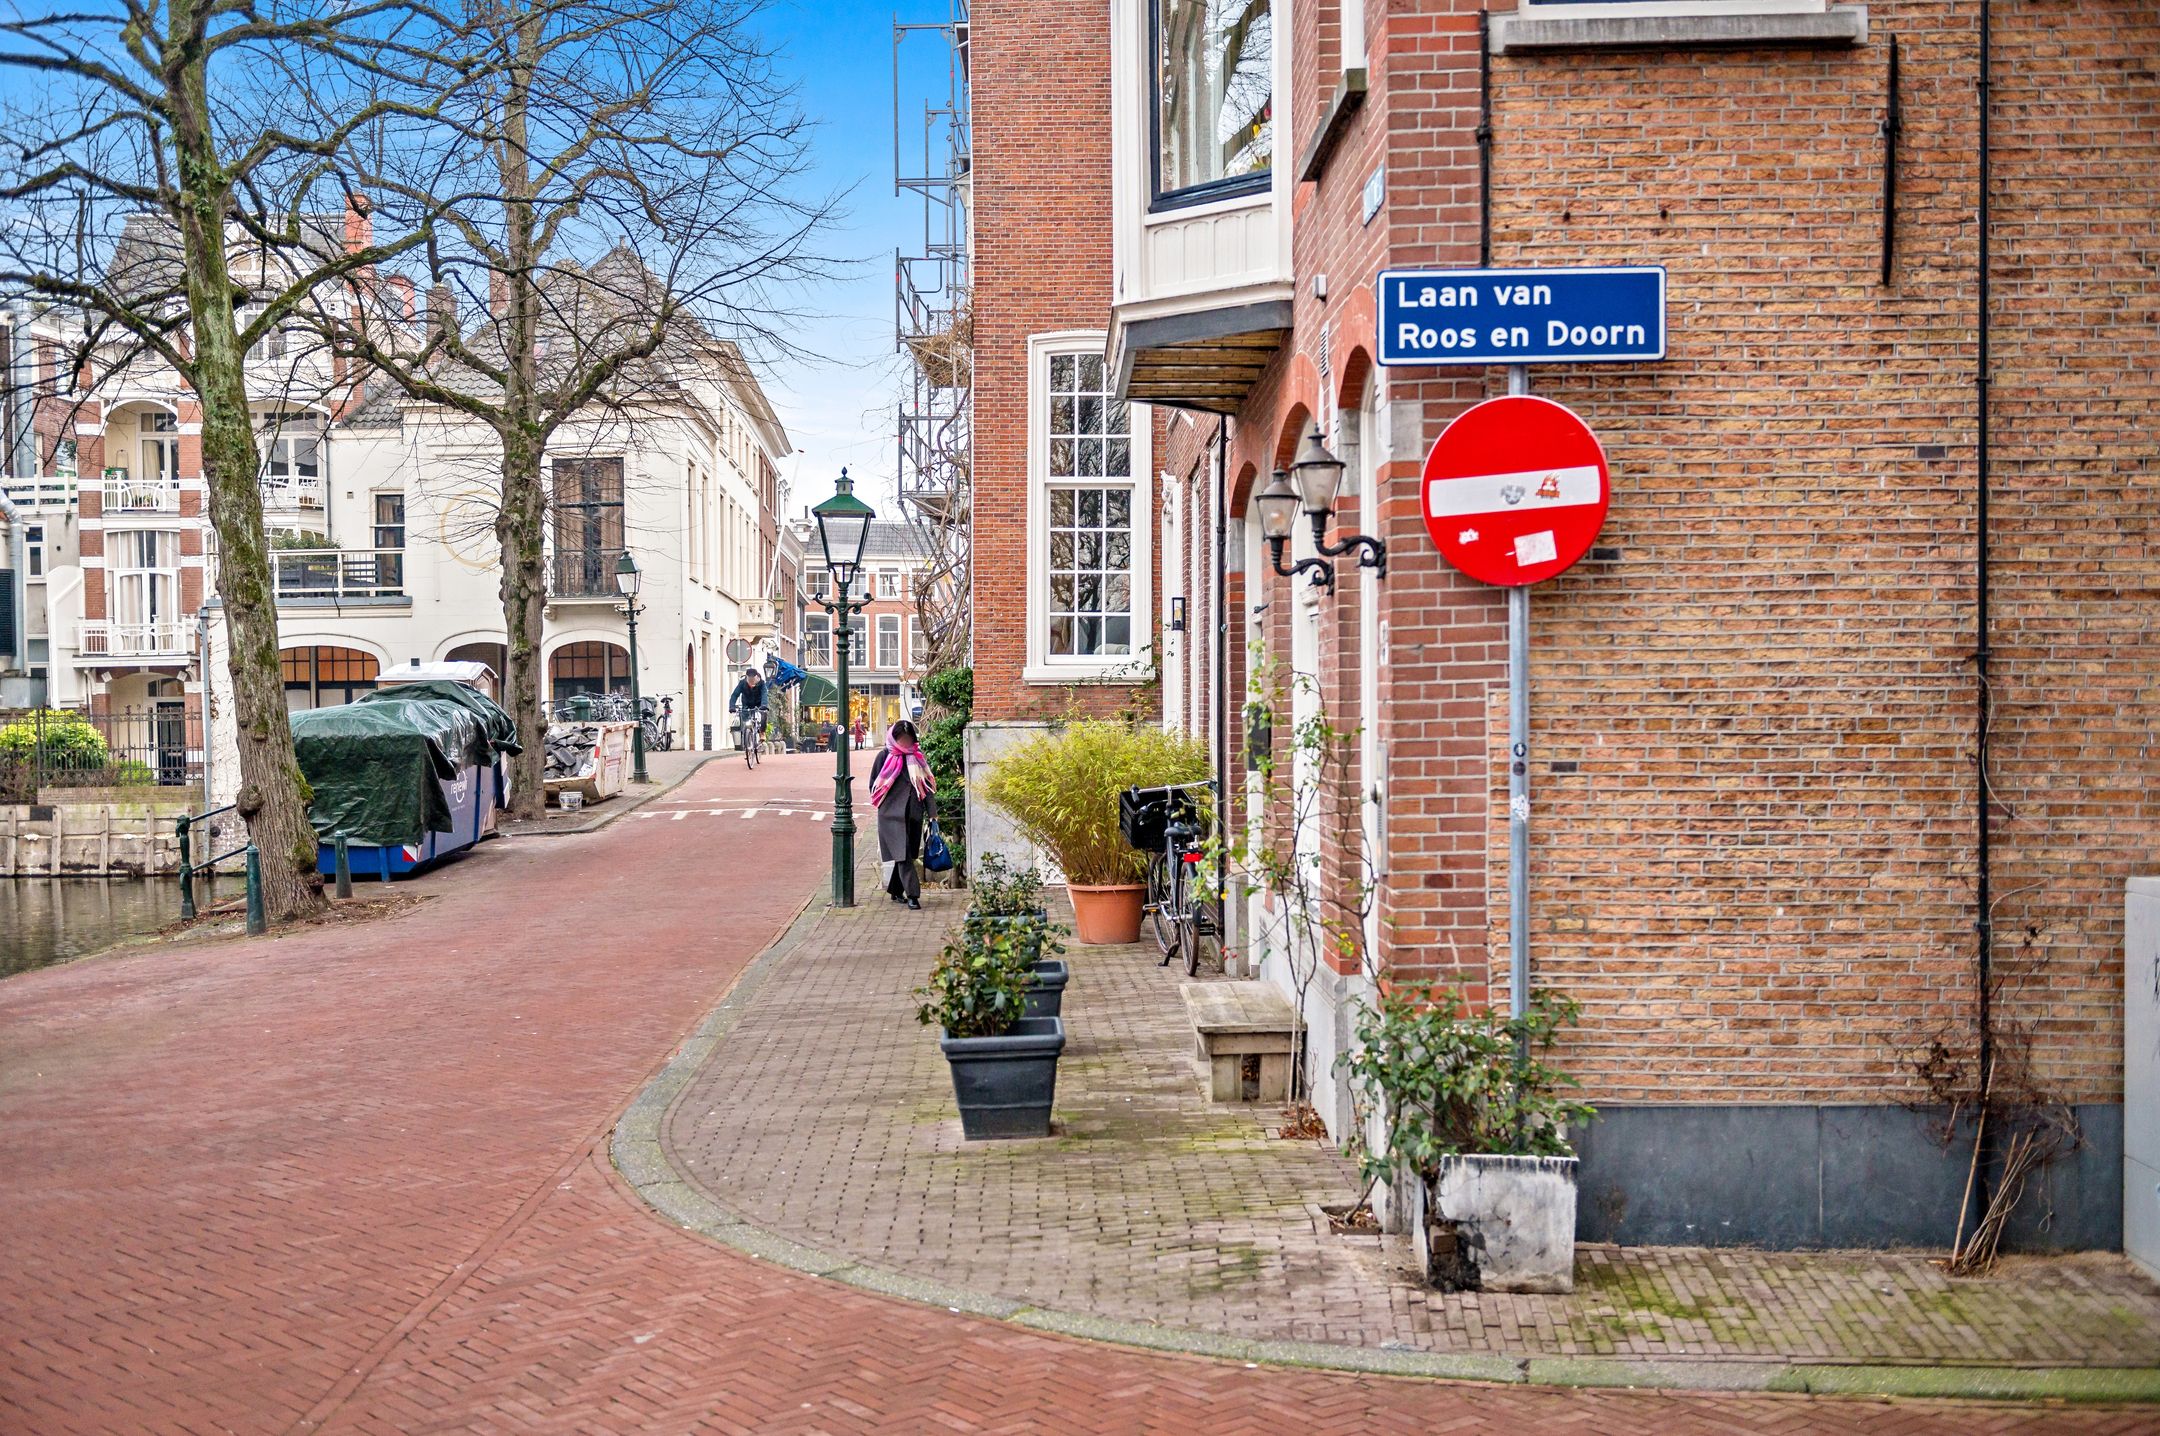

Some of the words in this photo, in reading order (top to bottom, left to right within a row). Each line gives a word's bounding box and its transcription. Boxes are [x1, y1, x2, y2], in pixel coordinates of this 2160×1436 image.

[1398, 281, 1478, 307] Laan
[1493, 284, 1551, 306] van
[1398, 322, 1476, 349] Roos
[1490, 326, 1530, 348] en
[1547, 320, 1645, 347] Doorn
